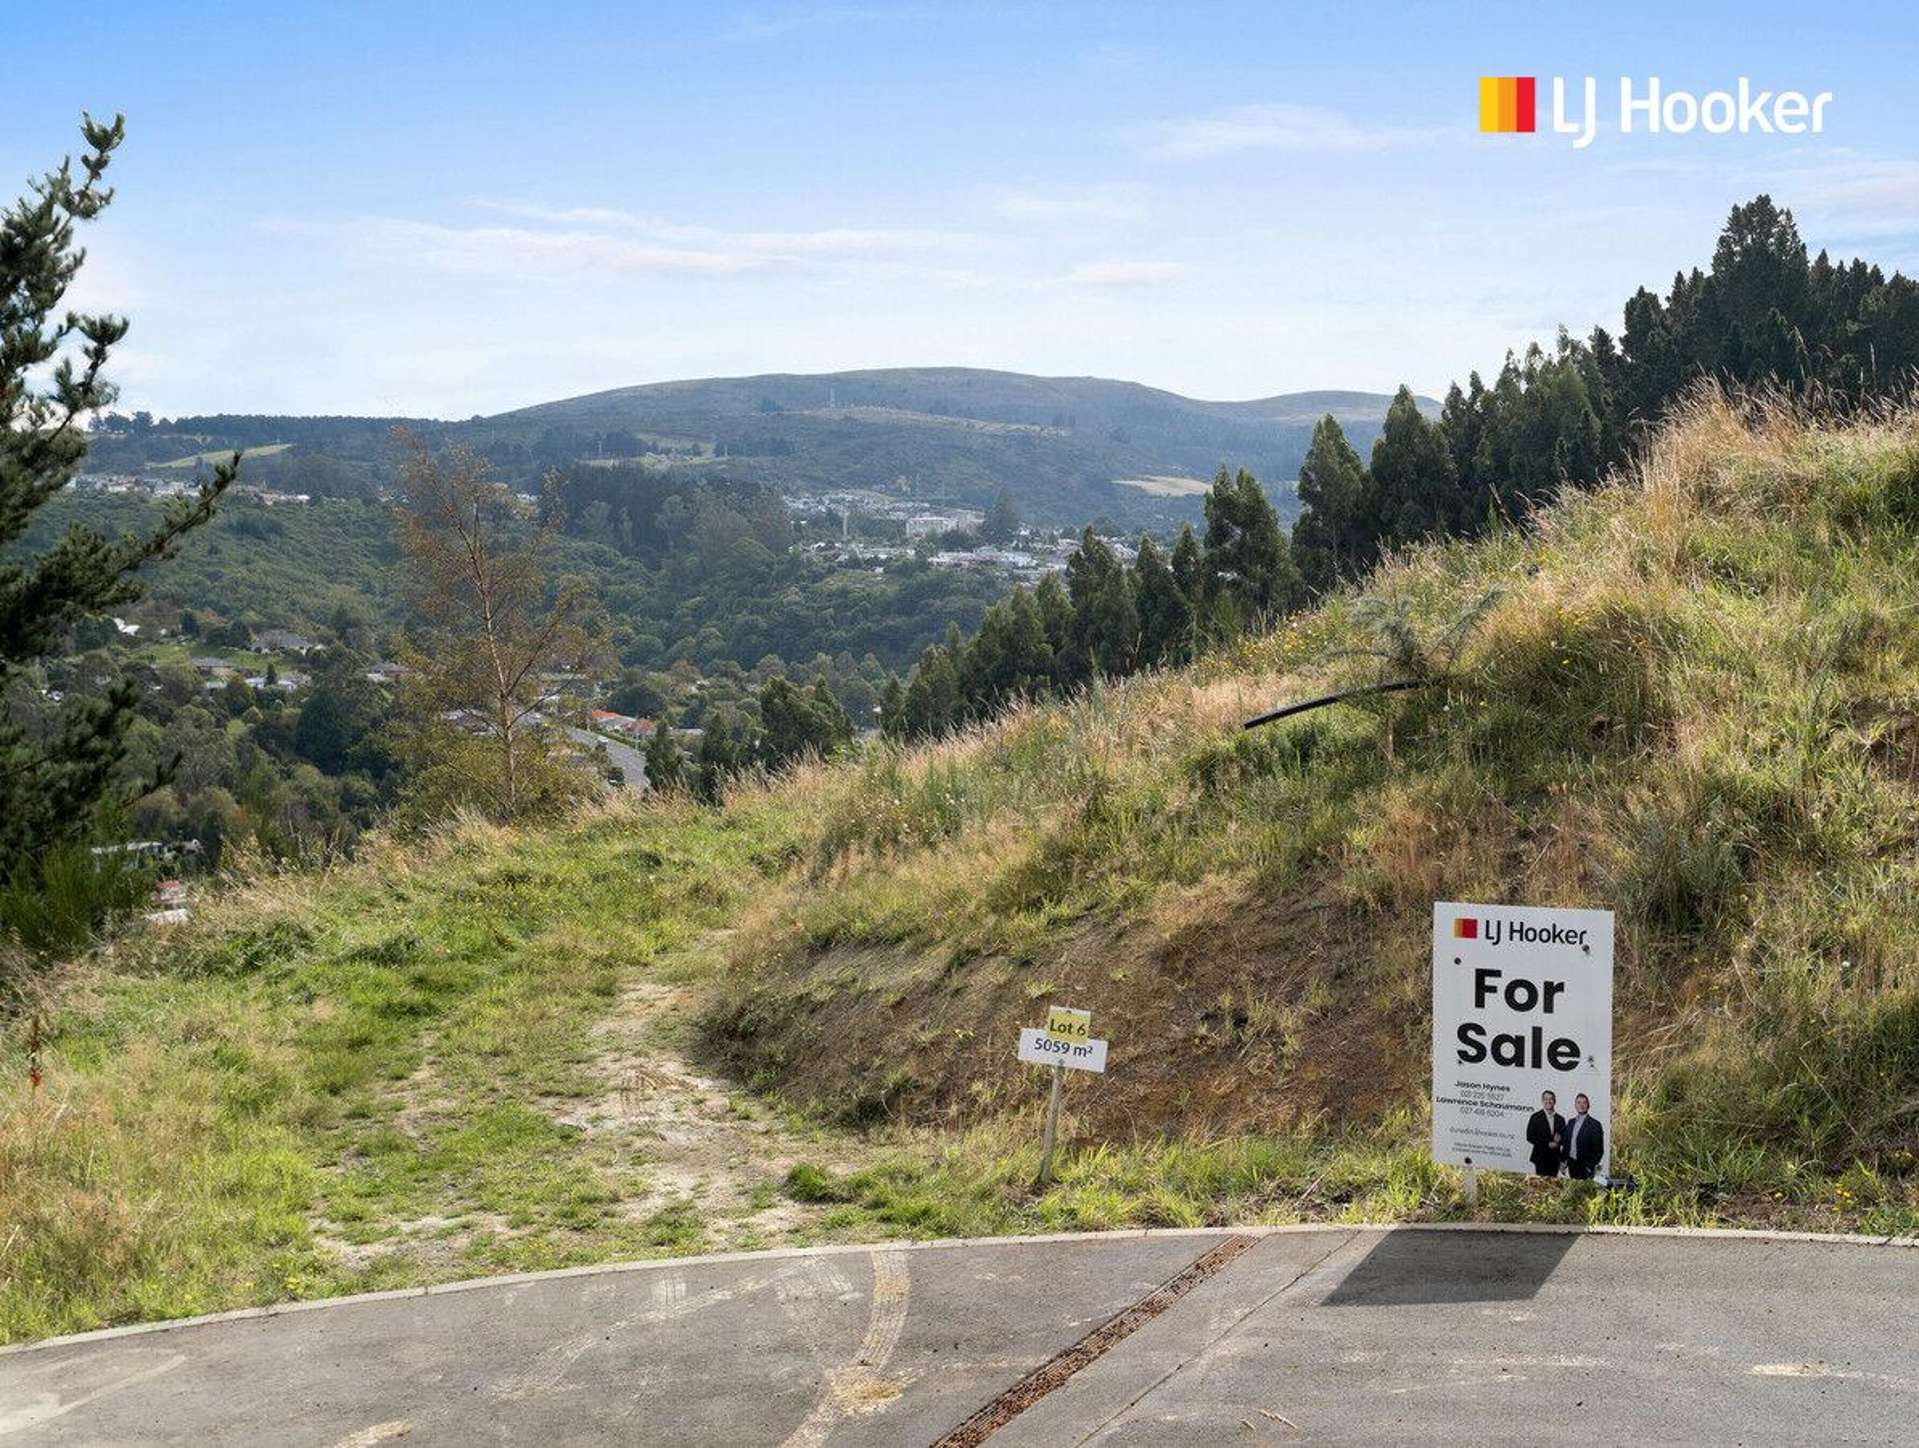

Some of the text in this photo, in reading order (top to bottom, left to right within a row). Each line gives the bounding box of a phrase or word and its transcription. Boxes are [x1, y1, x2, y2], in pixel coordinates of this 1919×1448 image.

[1485, 919, 1588, 946] LJ Hooker
[1474, 967, 1565, 1014] For
[1049, 1018, 1086, 1036] Lot 6
[1034, 1037, 1071, 1054] 5059
[1456, 1022, 1581, 1072] Sale
[1454, 1080, 1510, 1092] Jason Hynes
[1436, 1095, 1478, 1106] Lawrence
